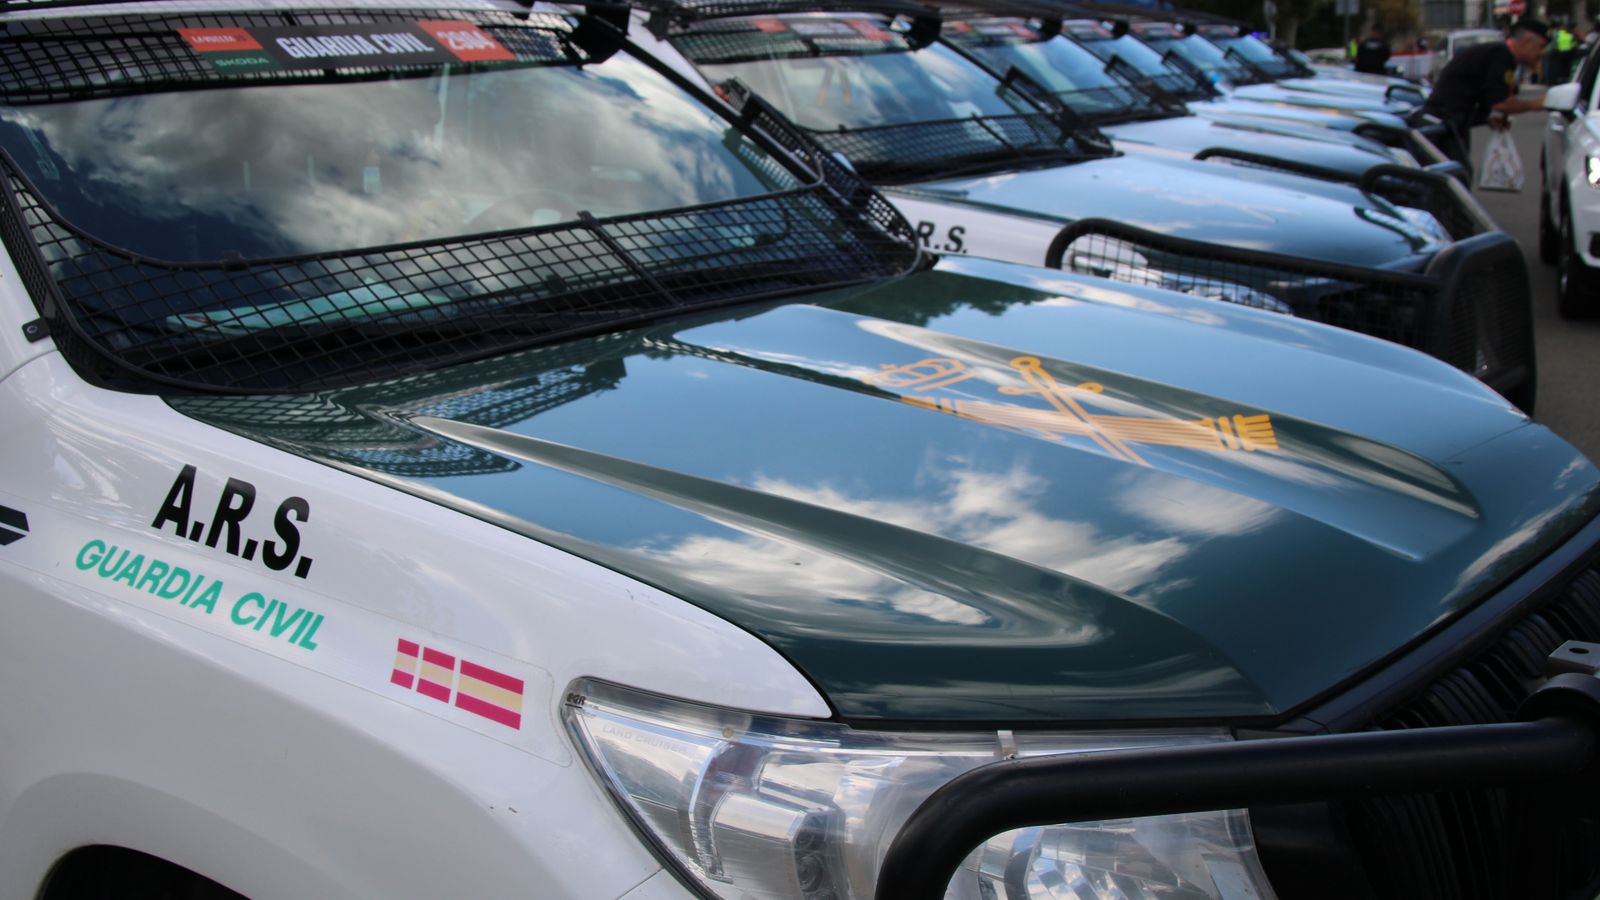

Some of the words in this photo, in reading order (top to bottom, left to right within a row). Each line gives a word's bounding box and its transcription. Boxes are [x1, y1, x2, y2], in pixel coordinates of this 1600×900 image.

[275, 34, 383, 59] GUARDIA
[369, 31, 435, 54] CIVIL
[215, 57, 270, 67] SKODA
[916, 220, 968, 255] R.S.
[151, 463, 313, 580] A.R.S.
[75, 539, 224, 615] GUARDIA
[230, 591, 325, 652] CIVIL
[602, 724, 633, 740] LAND
